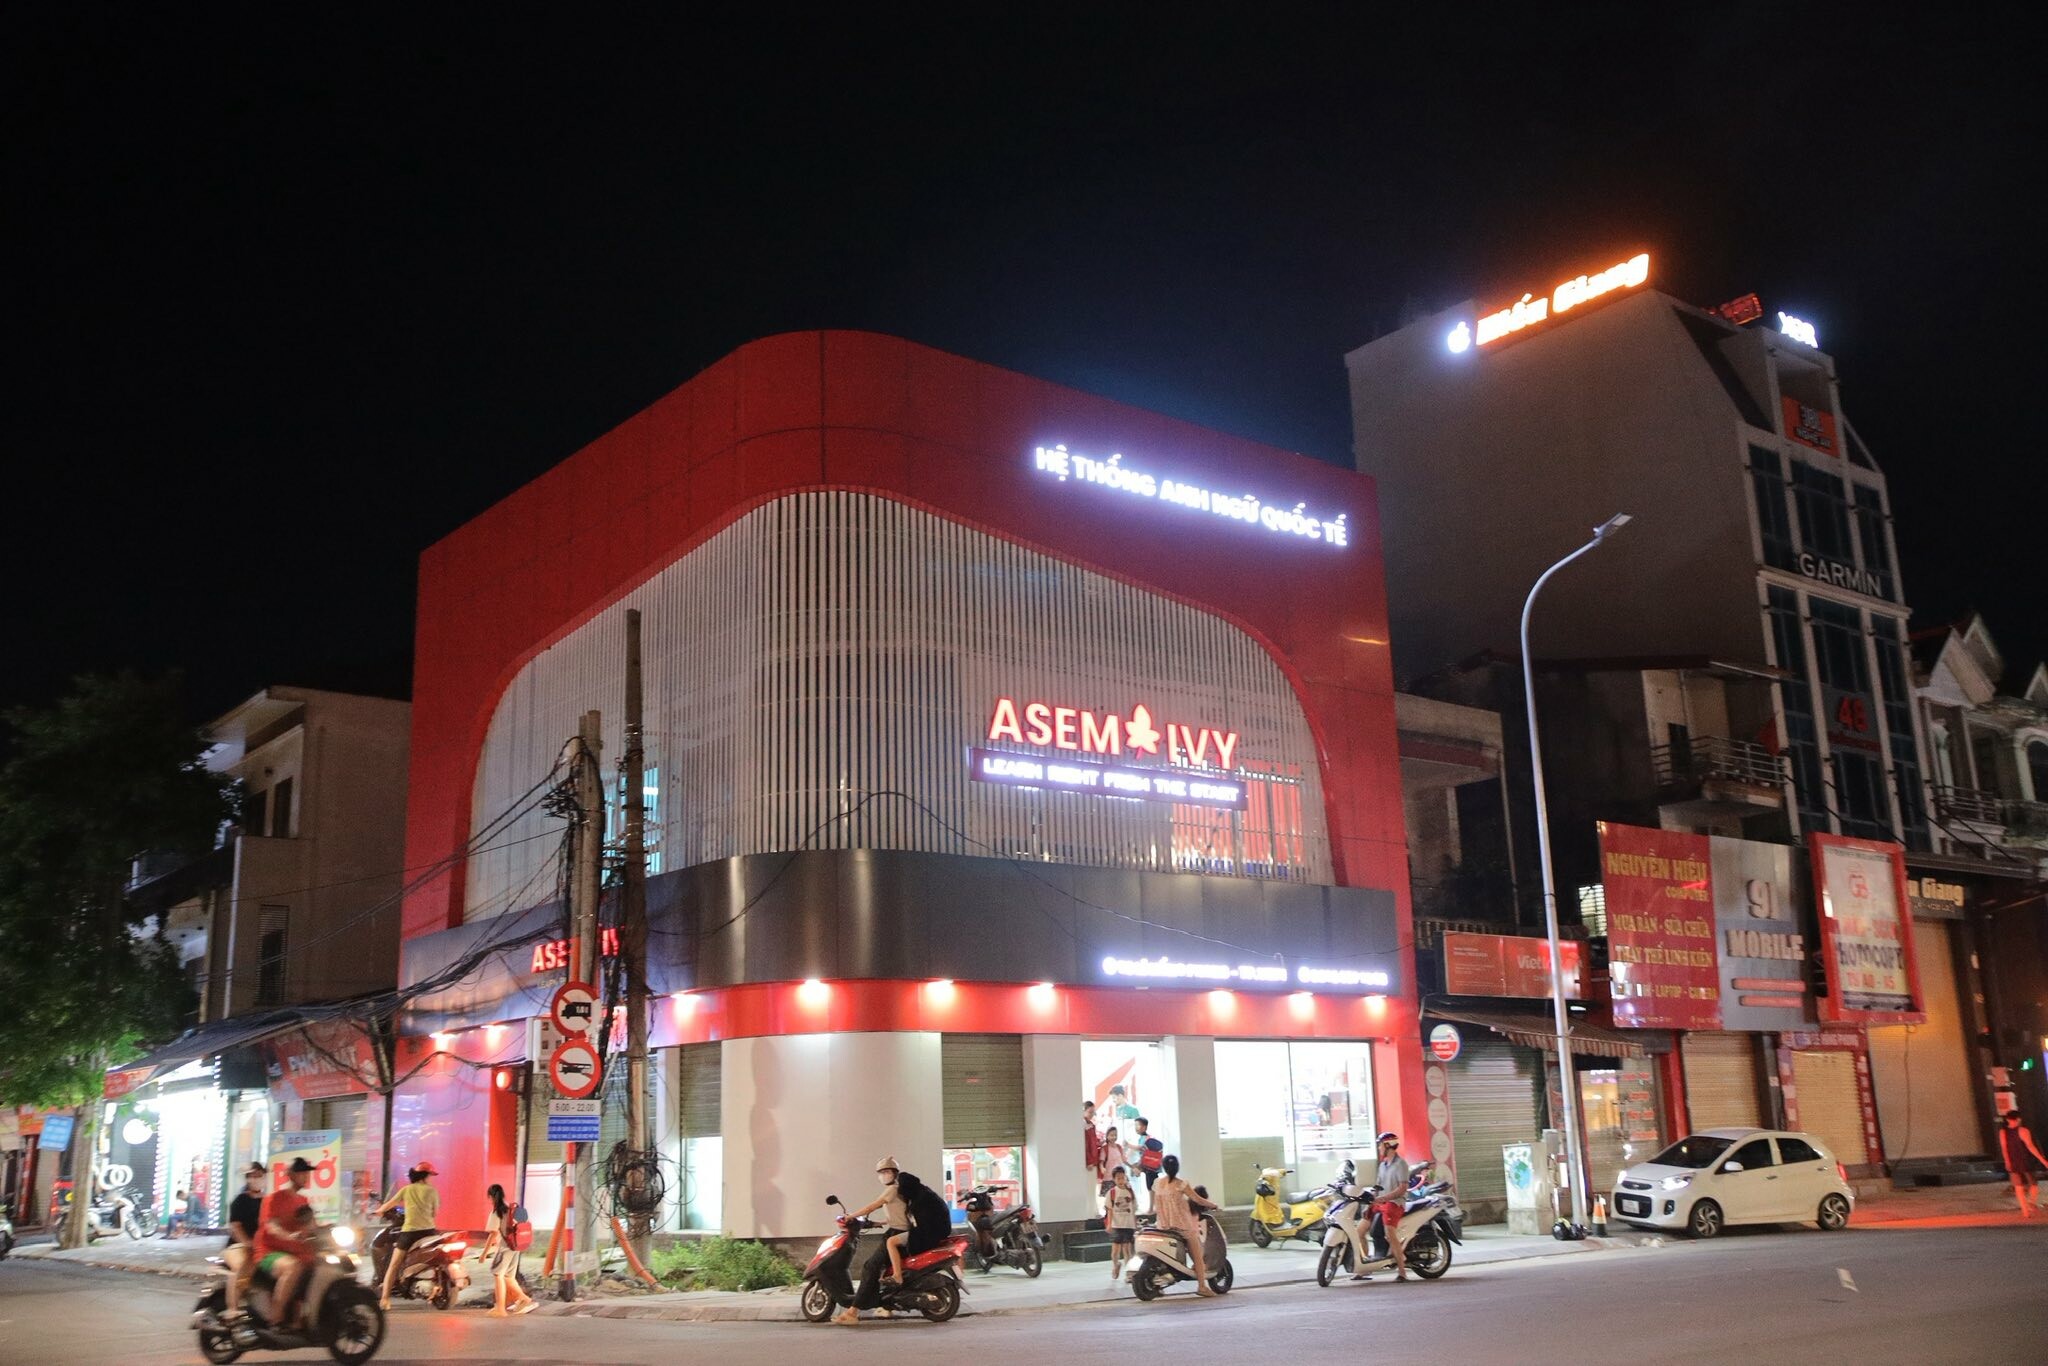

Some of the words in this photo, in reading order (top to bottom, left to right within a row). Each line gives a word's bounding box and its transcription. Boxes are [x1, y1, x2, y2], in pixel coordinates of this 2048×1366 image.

[1035, 444, 1069, 482] HỆ
[1072, 453, 1157, 497] THỐNG
[1160, 479, 1209, 512] ANH
[1212, 494, 1261, 524] NGỮ
[1261, 502, 1322, 540] QUỐC
[1322, 513, 1348, 547] TẾ
[1800, 552, 1883, 599] GARMIN
[988, 697, 1121, 756] ASEM
[1166, 722, 1238, 770] IVY
[1921, 877, 1965, 908] Giang
[530, 937, 575, 974] ASE
[1725, 929, 1805, 961] MOBILE
[1836, 941, 1905, 970] HOTOCOPY
